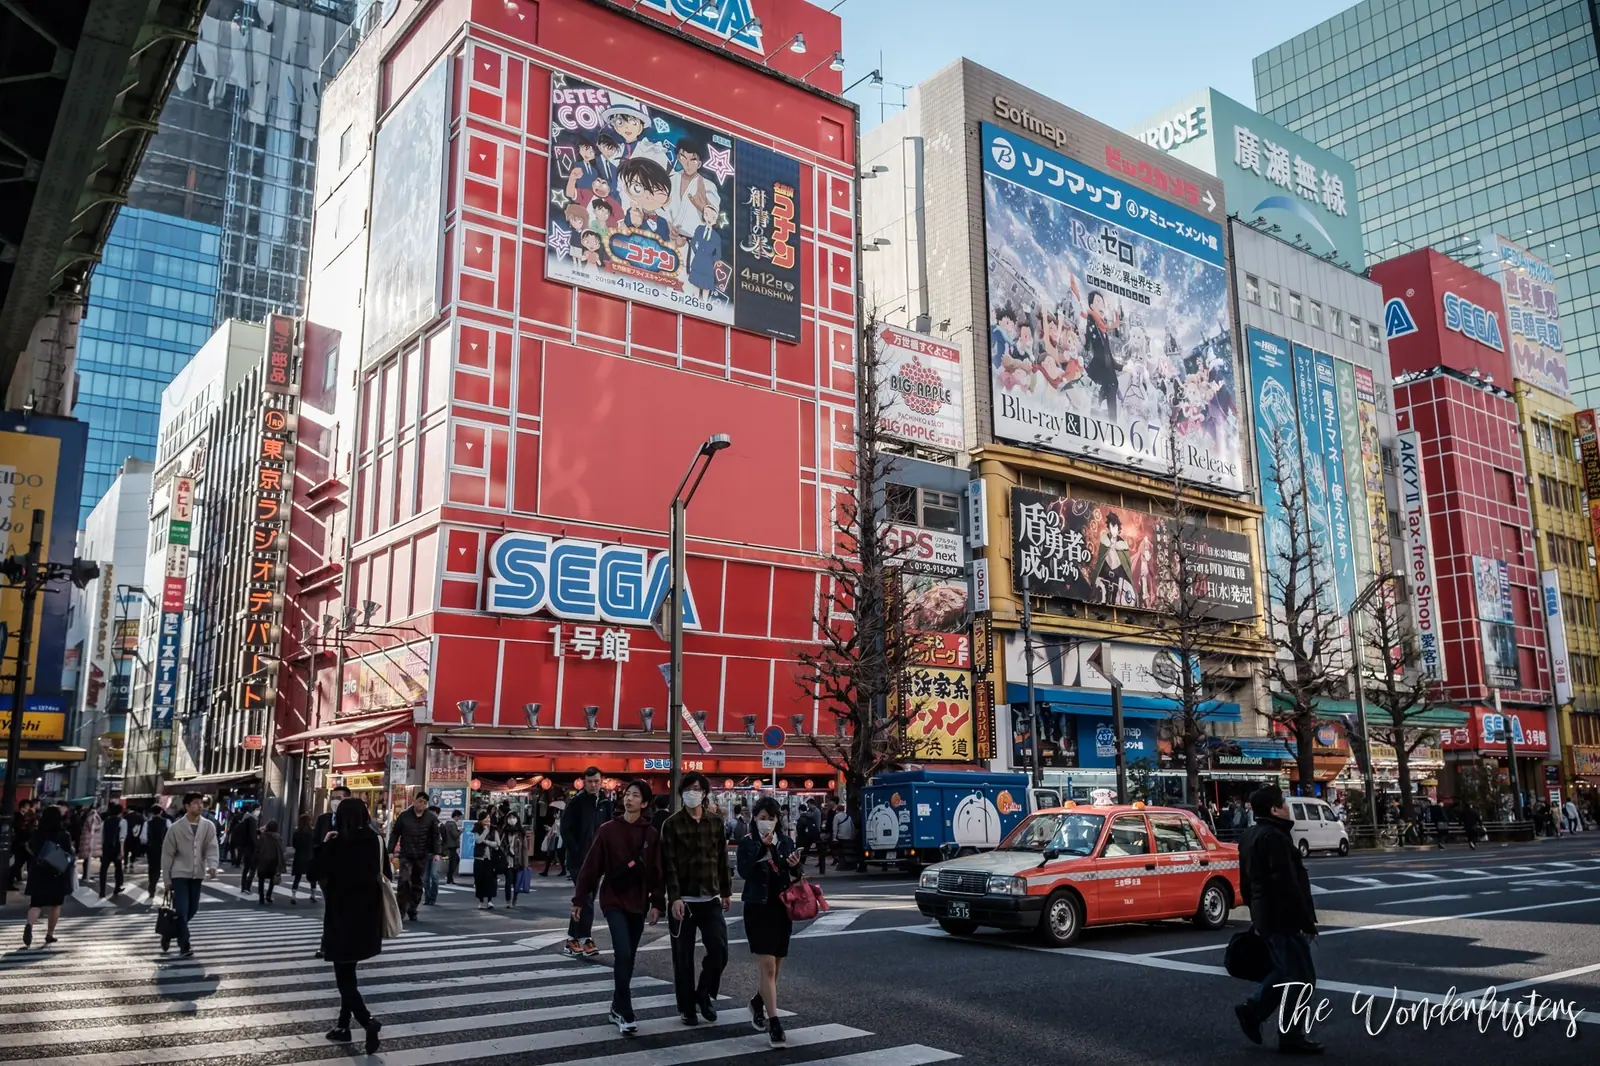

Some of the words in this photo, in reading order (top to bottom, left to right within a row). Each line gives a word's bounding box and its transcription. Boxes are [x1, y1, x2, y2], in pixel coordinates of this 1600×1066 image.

[994, 95, 1067, 148] Sofmap
[1022, 151, 1122, 211] ソフマップ
[1105, 144, 1199, 206] ビックカメラ
[741, 281, 793, 302] ROADSHOW
[1443, 291, 1505, 353] SEGA
[890, 375, 912, 393] BIG
[917, 383, 952, 404] APPLE
[879, 417, 900, 433] BIG
[1001, 393, 1064, 437] Blu-ray
[1067, 413, 1080, 436] &
[1083, 416, 1125, 448] DVD
[1187, 444, 1237, 477] Release
[1400, 439, 1418, 487] AKKY
[881, 527, 934, 559] GPS
[935, 550, 958, 563] next
[1407, 506, 1426, 581] Tax-free
[245, 438, 284, 708] 東京ラジオデパート
[487, 532, 702, 630] SEGA
[1416, 584, 1431, 630] Shop
[548, 624, 631, 663] 1号館
[958, 636, 969, 666] 2F
[1098, 733, 1112, 741] 437
